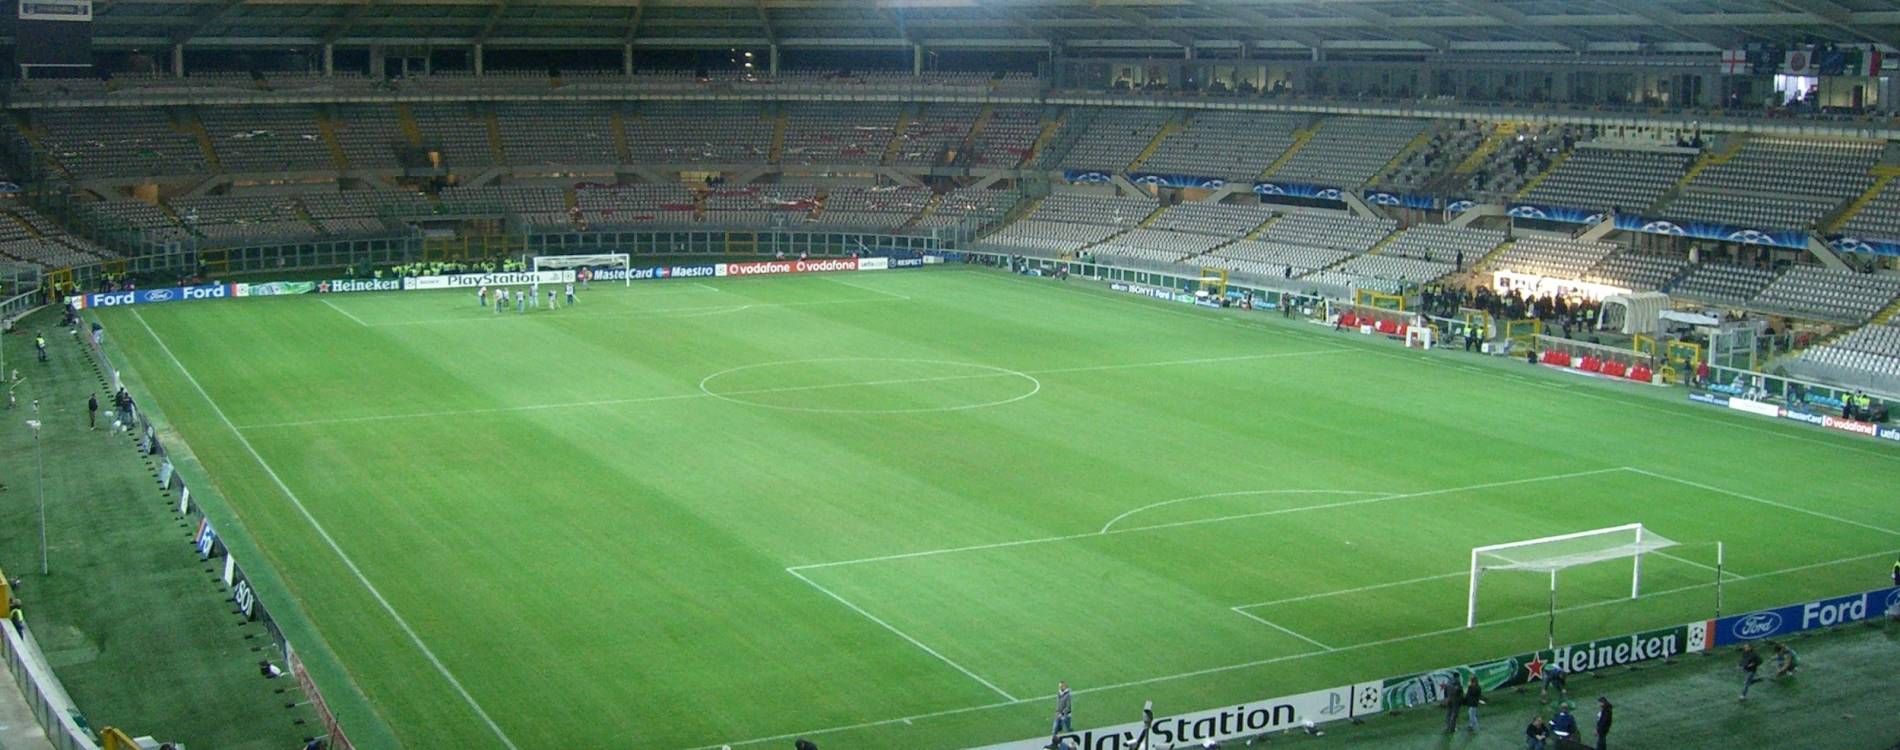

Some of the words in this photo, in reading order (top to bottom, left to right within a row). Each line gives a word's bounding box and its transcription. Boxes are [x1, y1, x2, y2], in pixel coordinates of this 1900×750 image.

[806, 261, 855, 272] vodafone
[897, 258, 922, 266] RESPECT
[671, 265, 713, 277] Maestro
[740, 263, 790, 274] vodafone
[448, 273, 540, 286] PlayStation
[183, 285, 225, 299] Ford
[332, 280, 399, 292] Heineken
[94, 292, 135, 306] Ford
[1156, 289, 1170, 300] Ford
[1833, 420, 1872, 434] vodafone
[1802, 593, 1868, 629] Ford
[1553, 634, 1677, 673] Heineken
